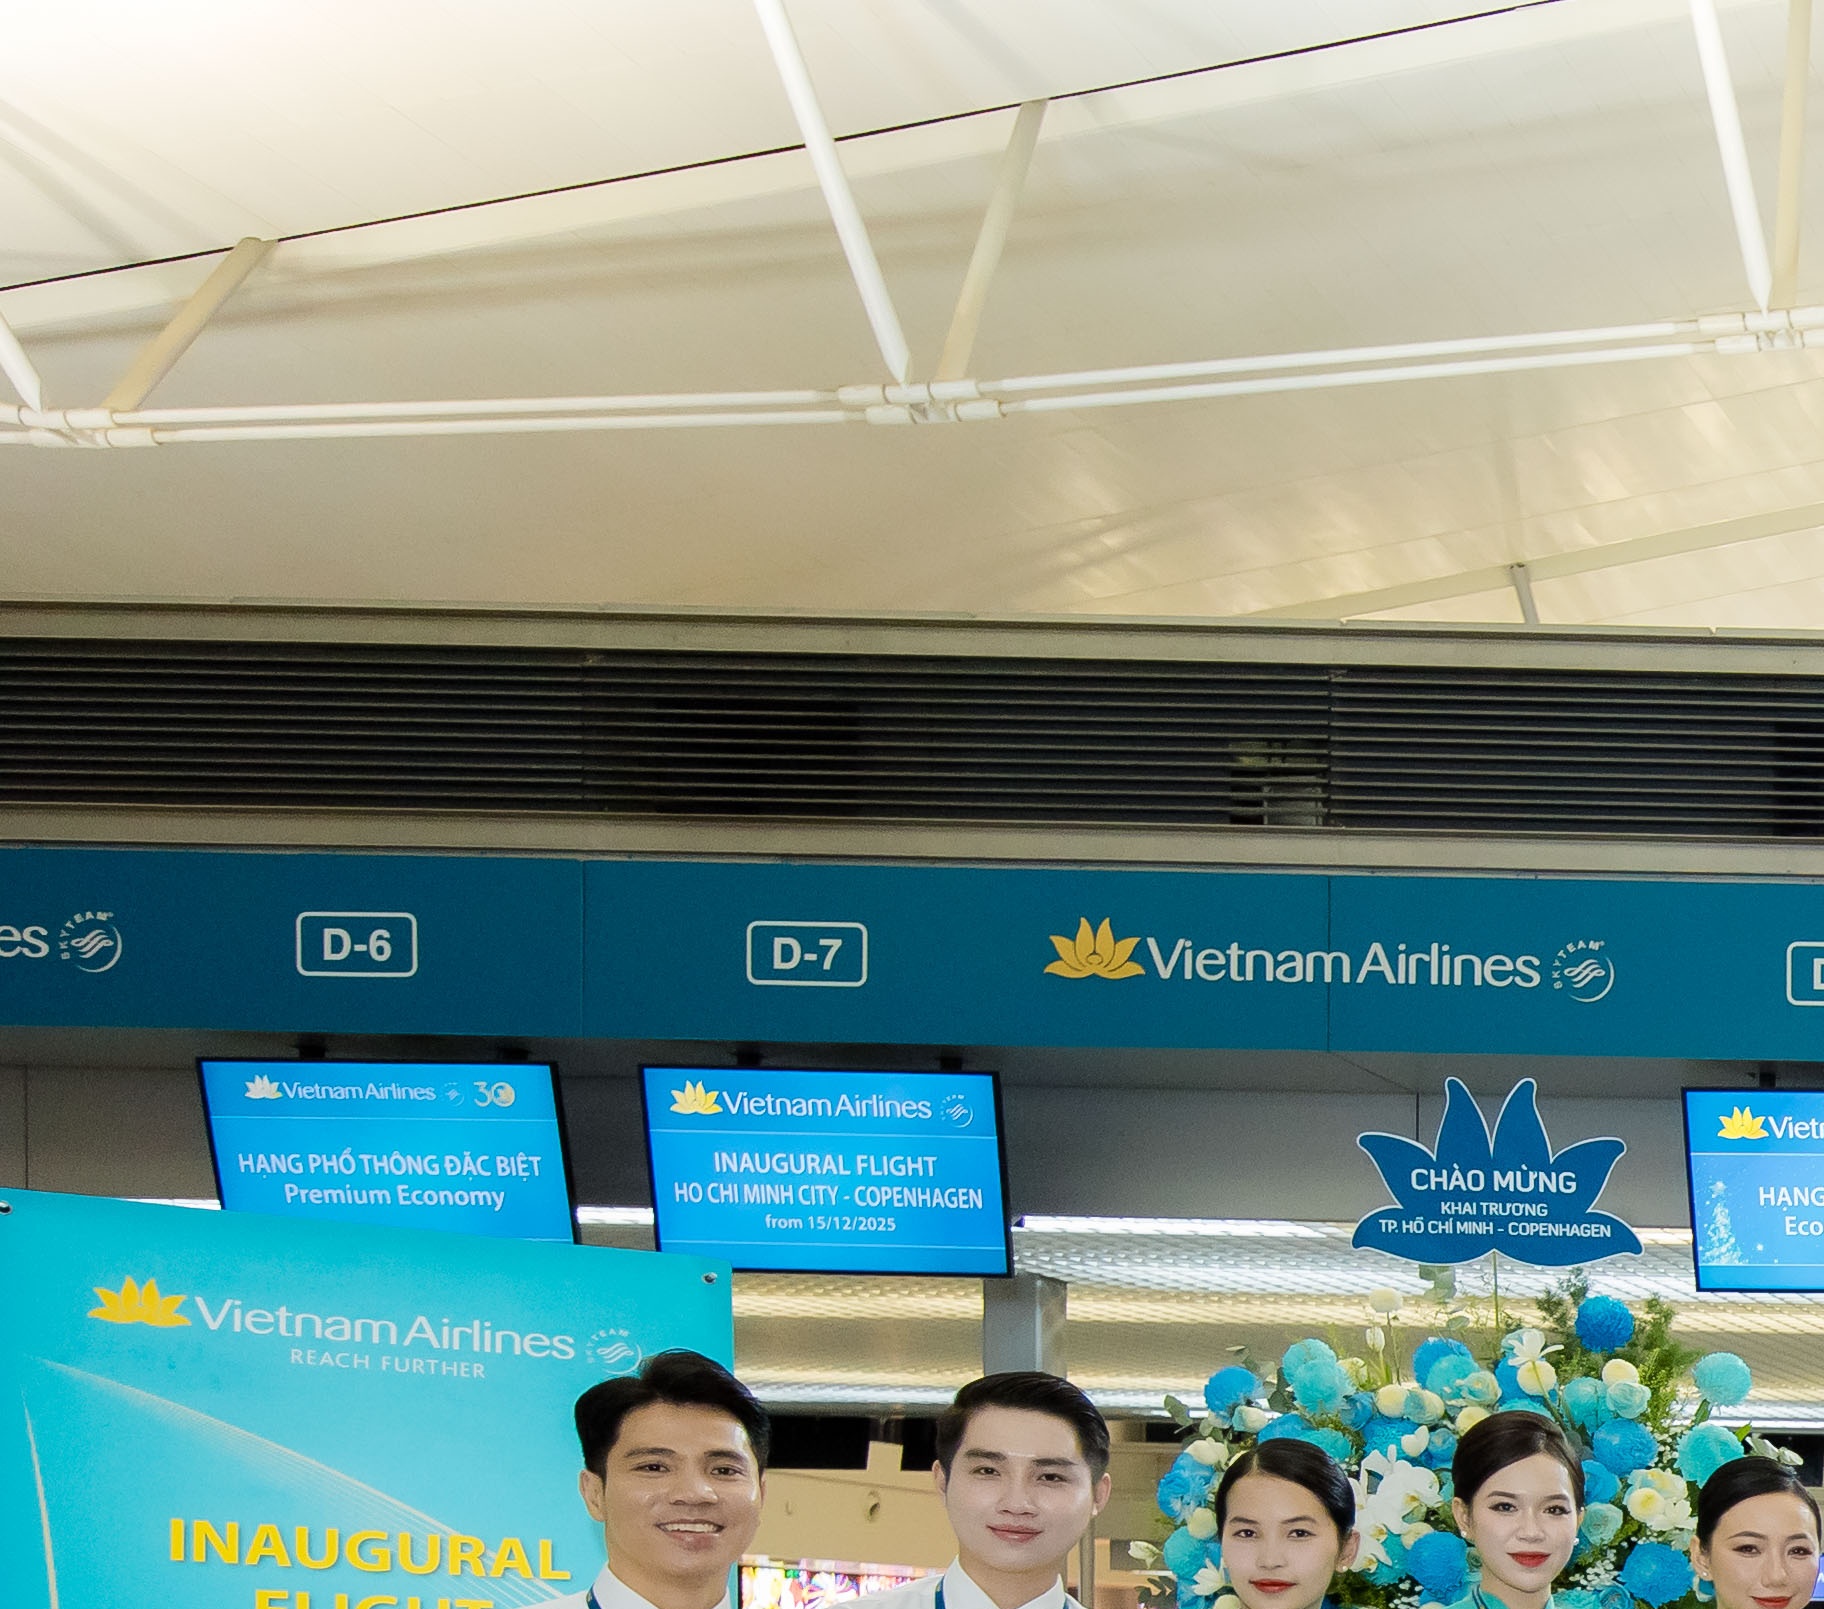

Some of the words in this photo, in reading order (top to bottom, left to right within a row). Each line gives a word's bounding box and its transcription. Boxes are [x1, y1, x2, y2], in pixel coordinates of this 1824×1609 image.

[323, 929, 391, 961] D-6
[772, 939, 842, 971] D-7
[1146, 936, 1350, 985] Vietnam
[1356, 941, 1541, 990] Airlines
[281, 1082, 363, 1100] Vietnam
[366, 1084, 436, 1101] Airlines
[722, 1091, 832, 1117] Vietnam
[834, 1094, 932, 1119] Airlines
[238, 1153, 302, 1179] HẠNG
[359, 1151, 440, 1177] THÔNG
[444, 1151, 491, 1181] ĐẶC
[496, 1152, 542, 1182] BIỆT
[714, 1151, 850, 1176] INAUGURAL
[856, 1155, 937, 1177] FLIGHT
[1411, 1164, 1485, 1192] CHÀO
[1493, 1164, 1577, 1193] MỪNG
[285, 1183, 391, 1205] Premium
[397, 1185, 505, 1211] Economy
[674, 1182, 703, 1203] HO
[707, 1182, 740, 1204] CHI
[744, 1184, 794, 1205] MINH
[797, 1185, 838, 1206] CITY
[854, 1186, 983, 1209] COPENHAGEN
[1441, 1202, 1476, 1215] KHAI
[1481, 1202, 1548, 1216] TRƯƠNG
[765, 1214, 803, 1229] from
[808, 1215, 896, 1231] 15/12/2025
[1379, 1219, 1398, 1233] TP.
[1427, 1217, 1454, 1234] CHÍ
[1456, 1221, 1494, 1235] MINH
[1508, 1222, 1612, 1238] COPENHAGEN
[195, 1295, 398, 1348] Vietnam
[403, 1314, 576, 1362] Airlines
[290, 1348, 371, 1373] REACH
[381, 1354, 486, 1380] FURTHER
[170, 1518, 571, 1581] INAUGURAL
